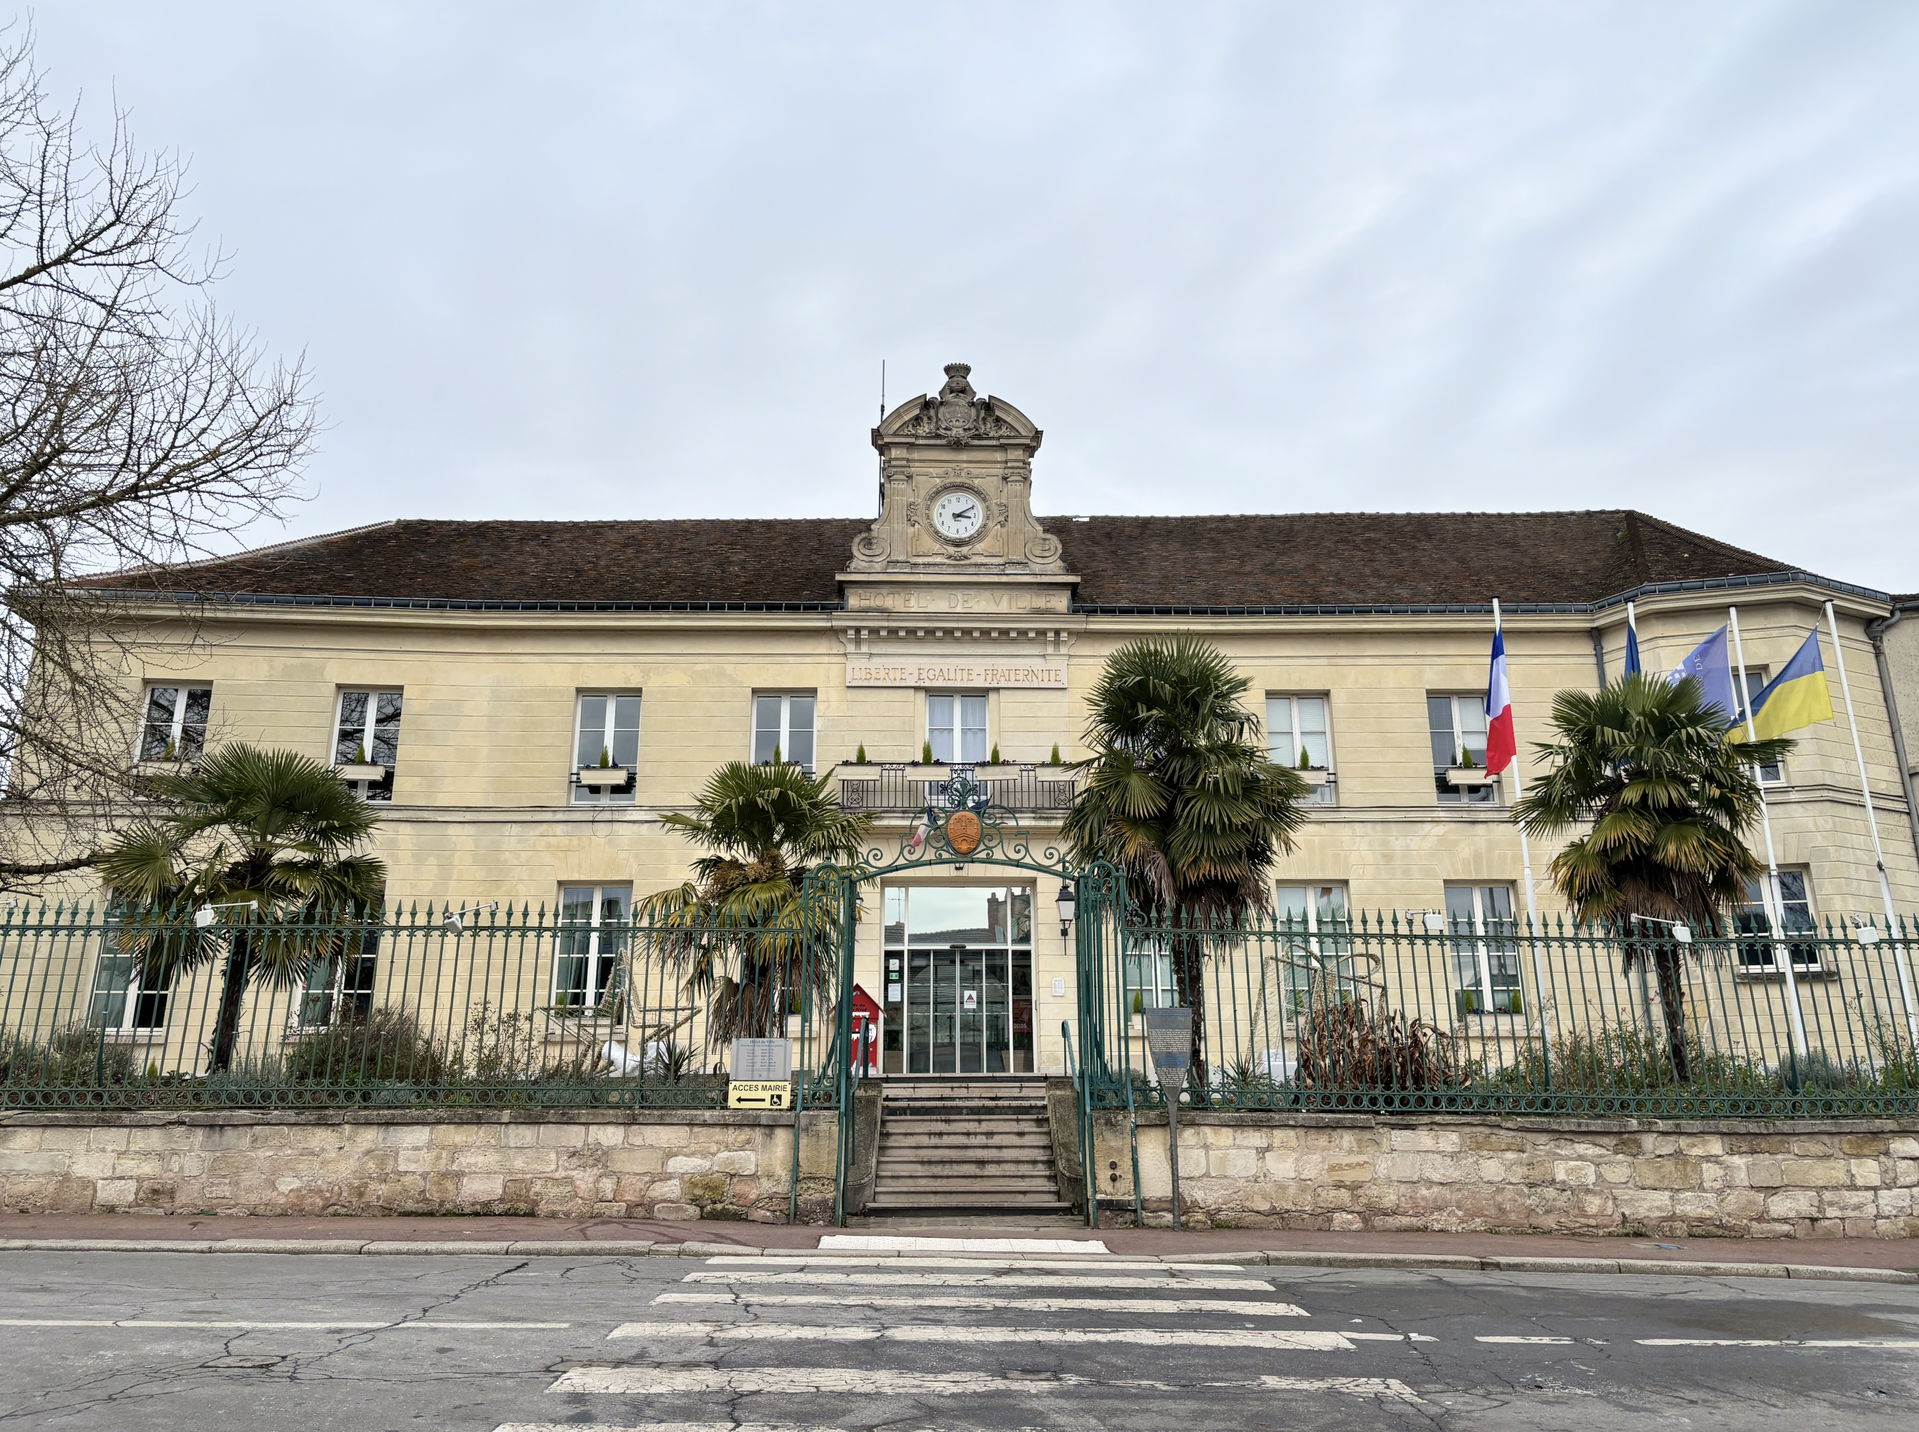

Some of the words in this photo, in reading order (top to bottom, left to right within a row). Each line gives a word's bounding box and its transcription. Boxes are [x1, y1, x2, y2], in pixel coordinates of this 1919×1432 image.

[858, 592, 929, 608] HOTEL
[948, 592, 973, 609] DE
[991, 593, 1057, 609] VILLE
[851, 667, 907, 681] LIBERTE
[917, 667, 974, 682] EGALITE
[984, 668, 1062, 682] FRATERNITE
[732, 1084, 759, 1092] ACCES
[761, 1084, 788, 1092] MAIRIE
